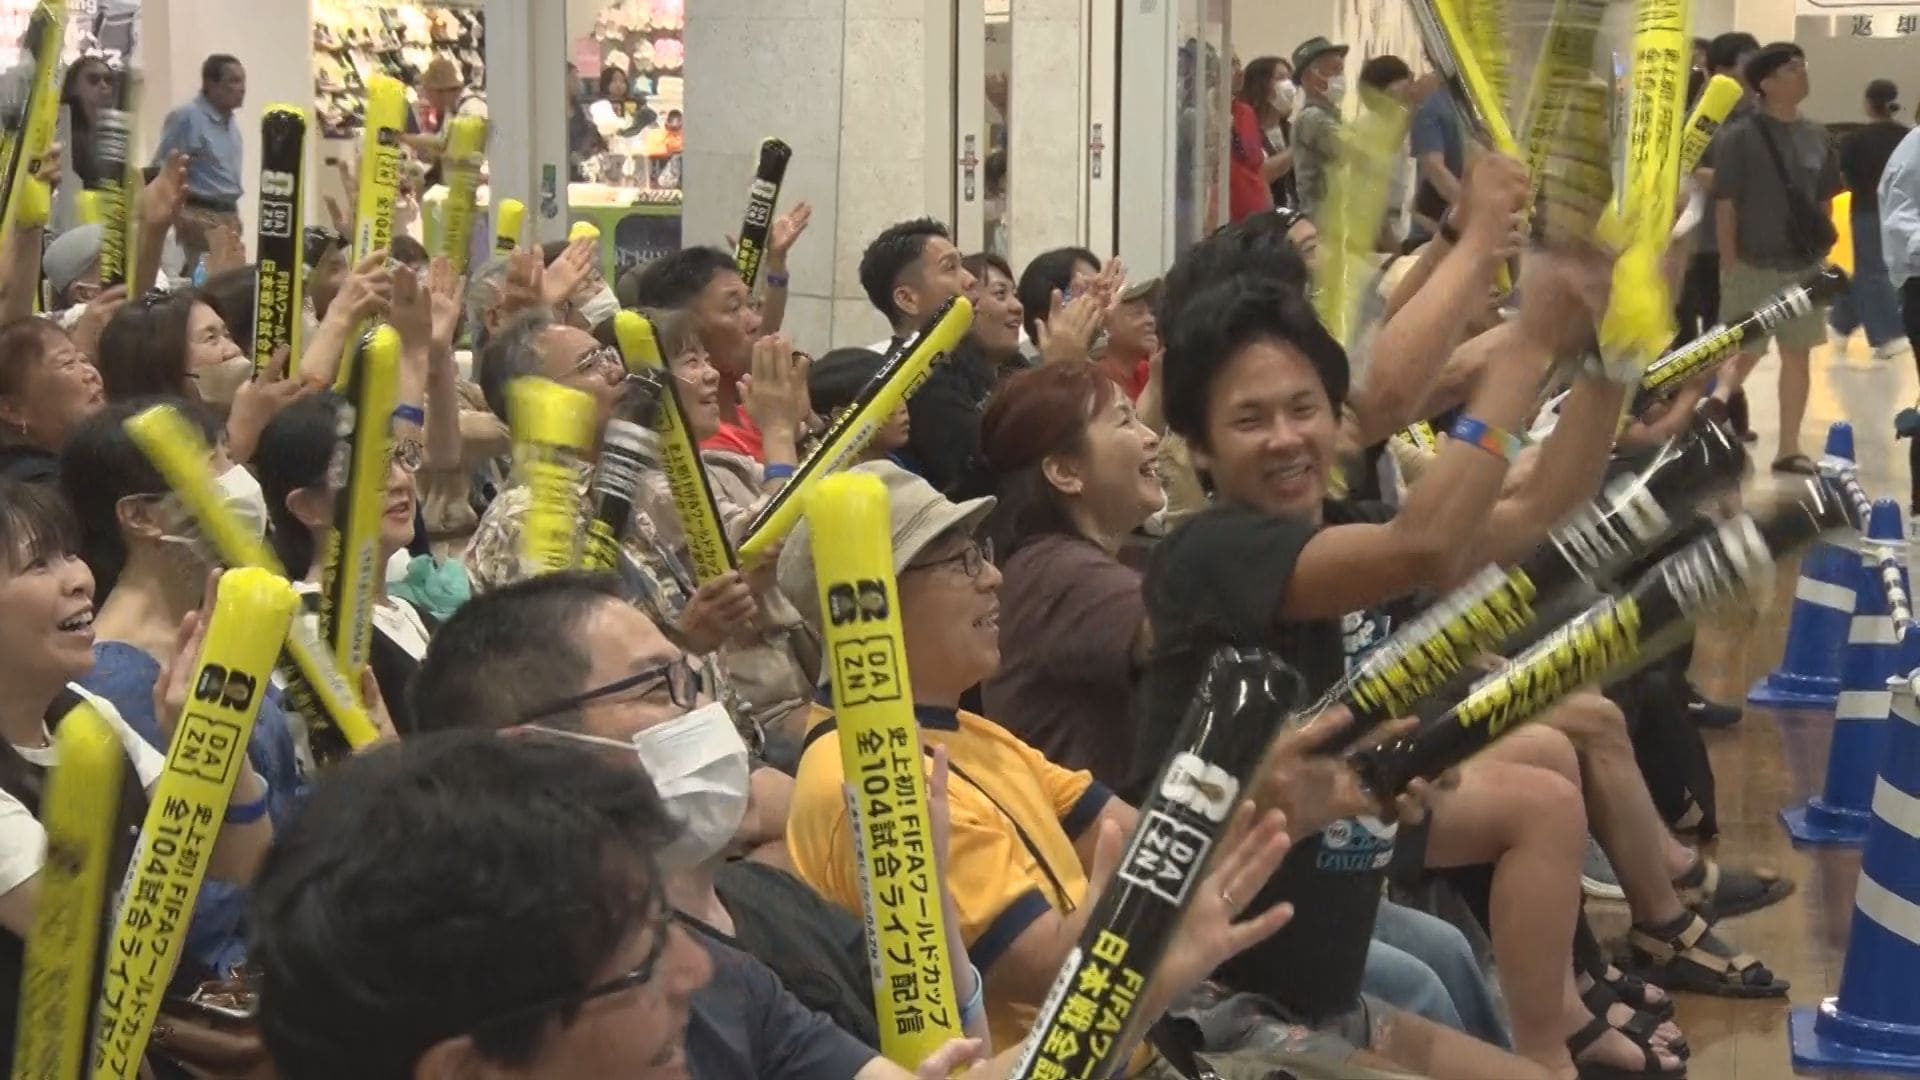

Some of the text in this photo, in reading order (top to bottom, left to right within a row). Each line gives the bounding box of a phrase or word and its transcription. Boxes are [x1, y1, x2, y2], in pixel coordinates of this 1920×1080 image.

[856, 727, 926, 1035] 全104試合ライブ配信
[1073, 968, 1144, 1080] FIFAワー
